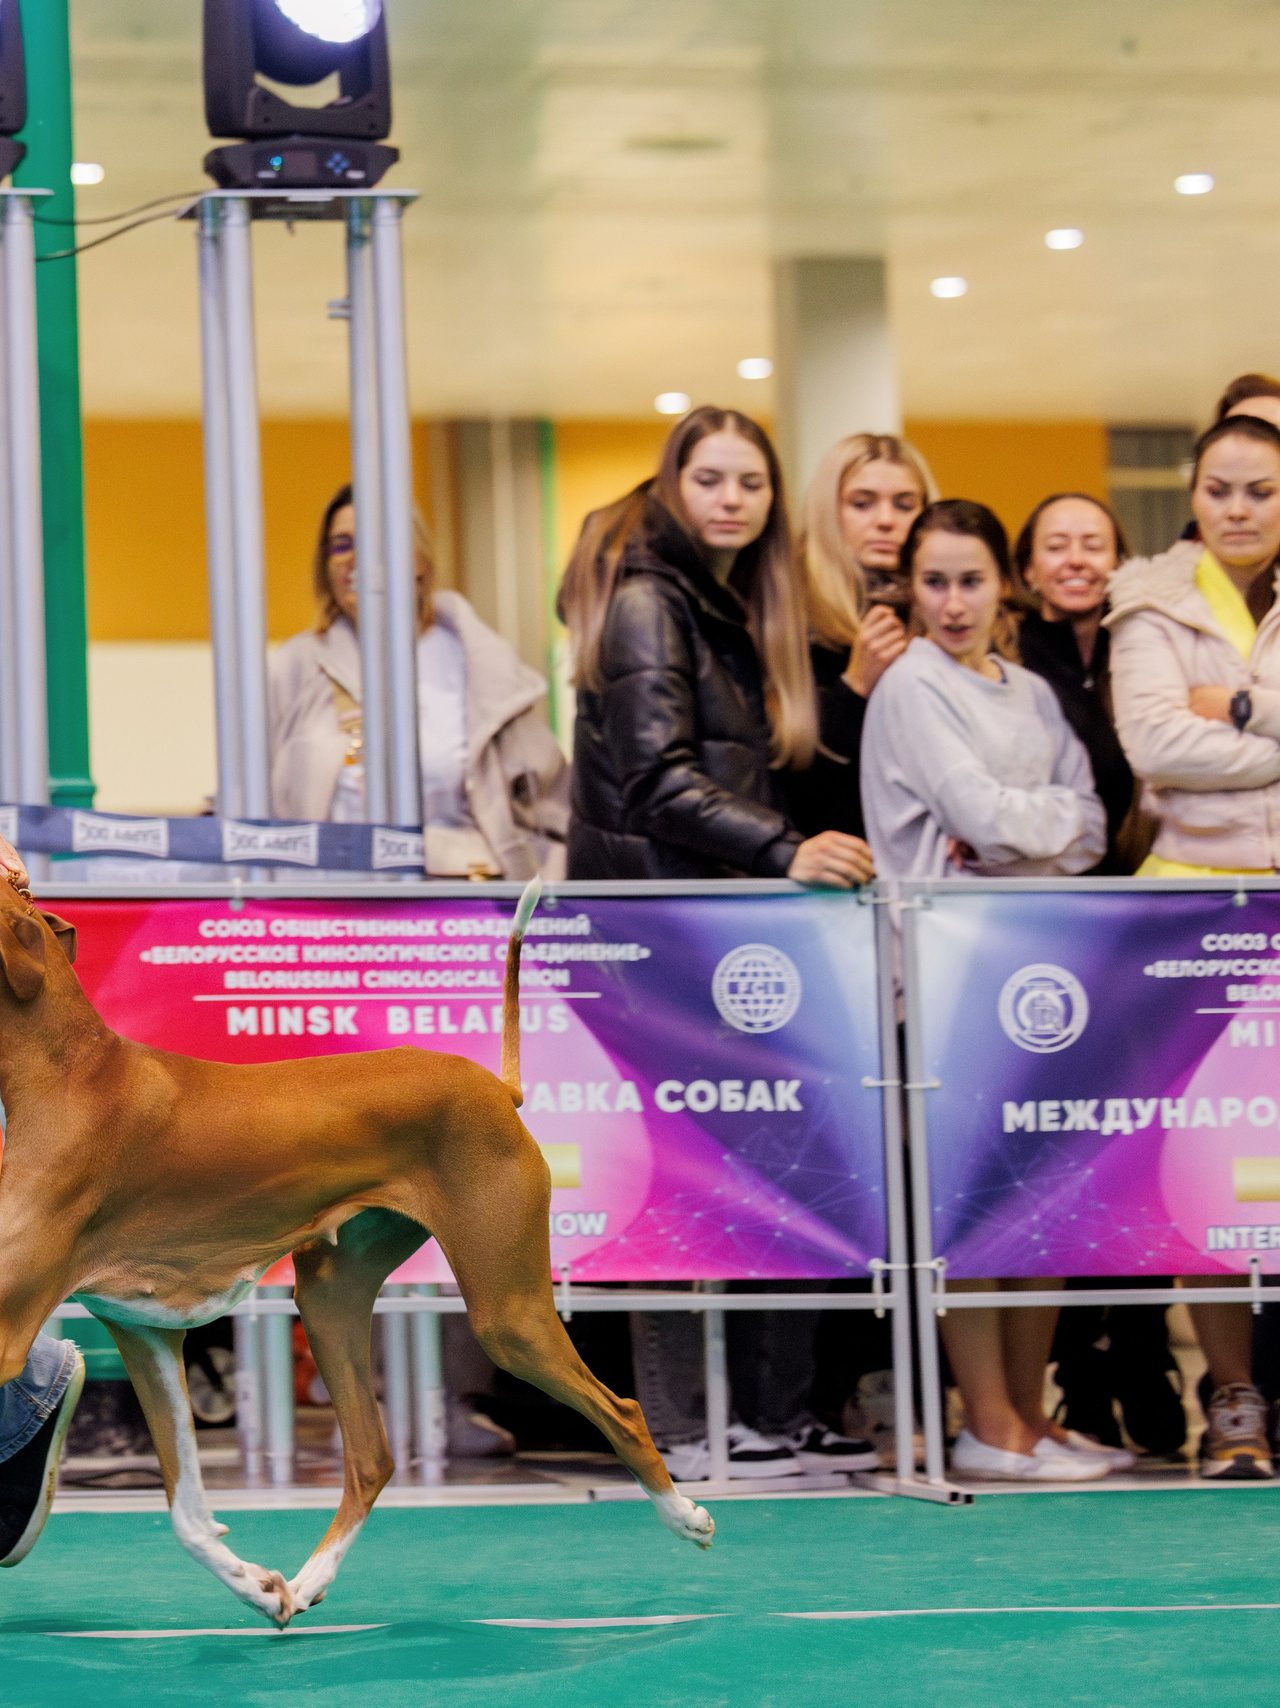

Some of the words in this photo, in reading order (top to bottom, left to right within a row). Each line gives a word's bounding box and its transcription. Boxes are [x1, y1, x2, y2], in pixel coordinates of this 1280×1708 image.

[199, 918, 266, 939] СОЮЗ
[269, 918, 438, 941] ОБЩЕСТВЕННЫХ
[441, 913, 591, 938] ОБЪЕДНЕНИЙ
[139, 944, 298, 965] «БЕЛОРУССКОЕ
[302, 943, 491, 963] КИНОЛОГИЧЕСКОЕ
[1201, 933, 1268, 952] СОЮЗ
[224, 969, 359, 989] BELORUSSIAN
[362, 969, 501, 988] CINOLOGICAL
[518, 968, 571, 988] NION
[227, 1005, 360, 1036] MINSK
[654, 1079, 804, 1114] СОБАК
